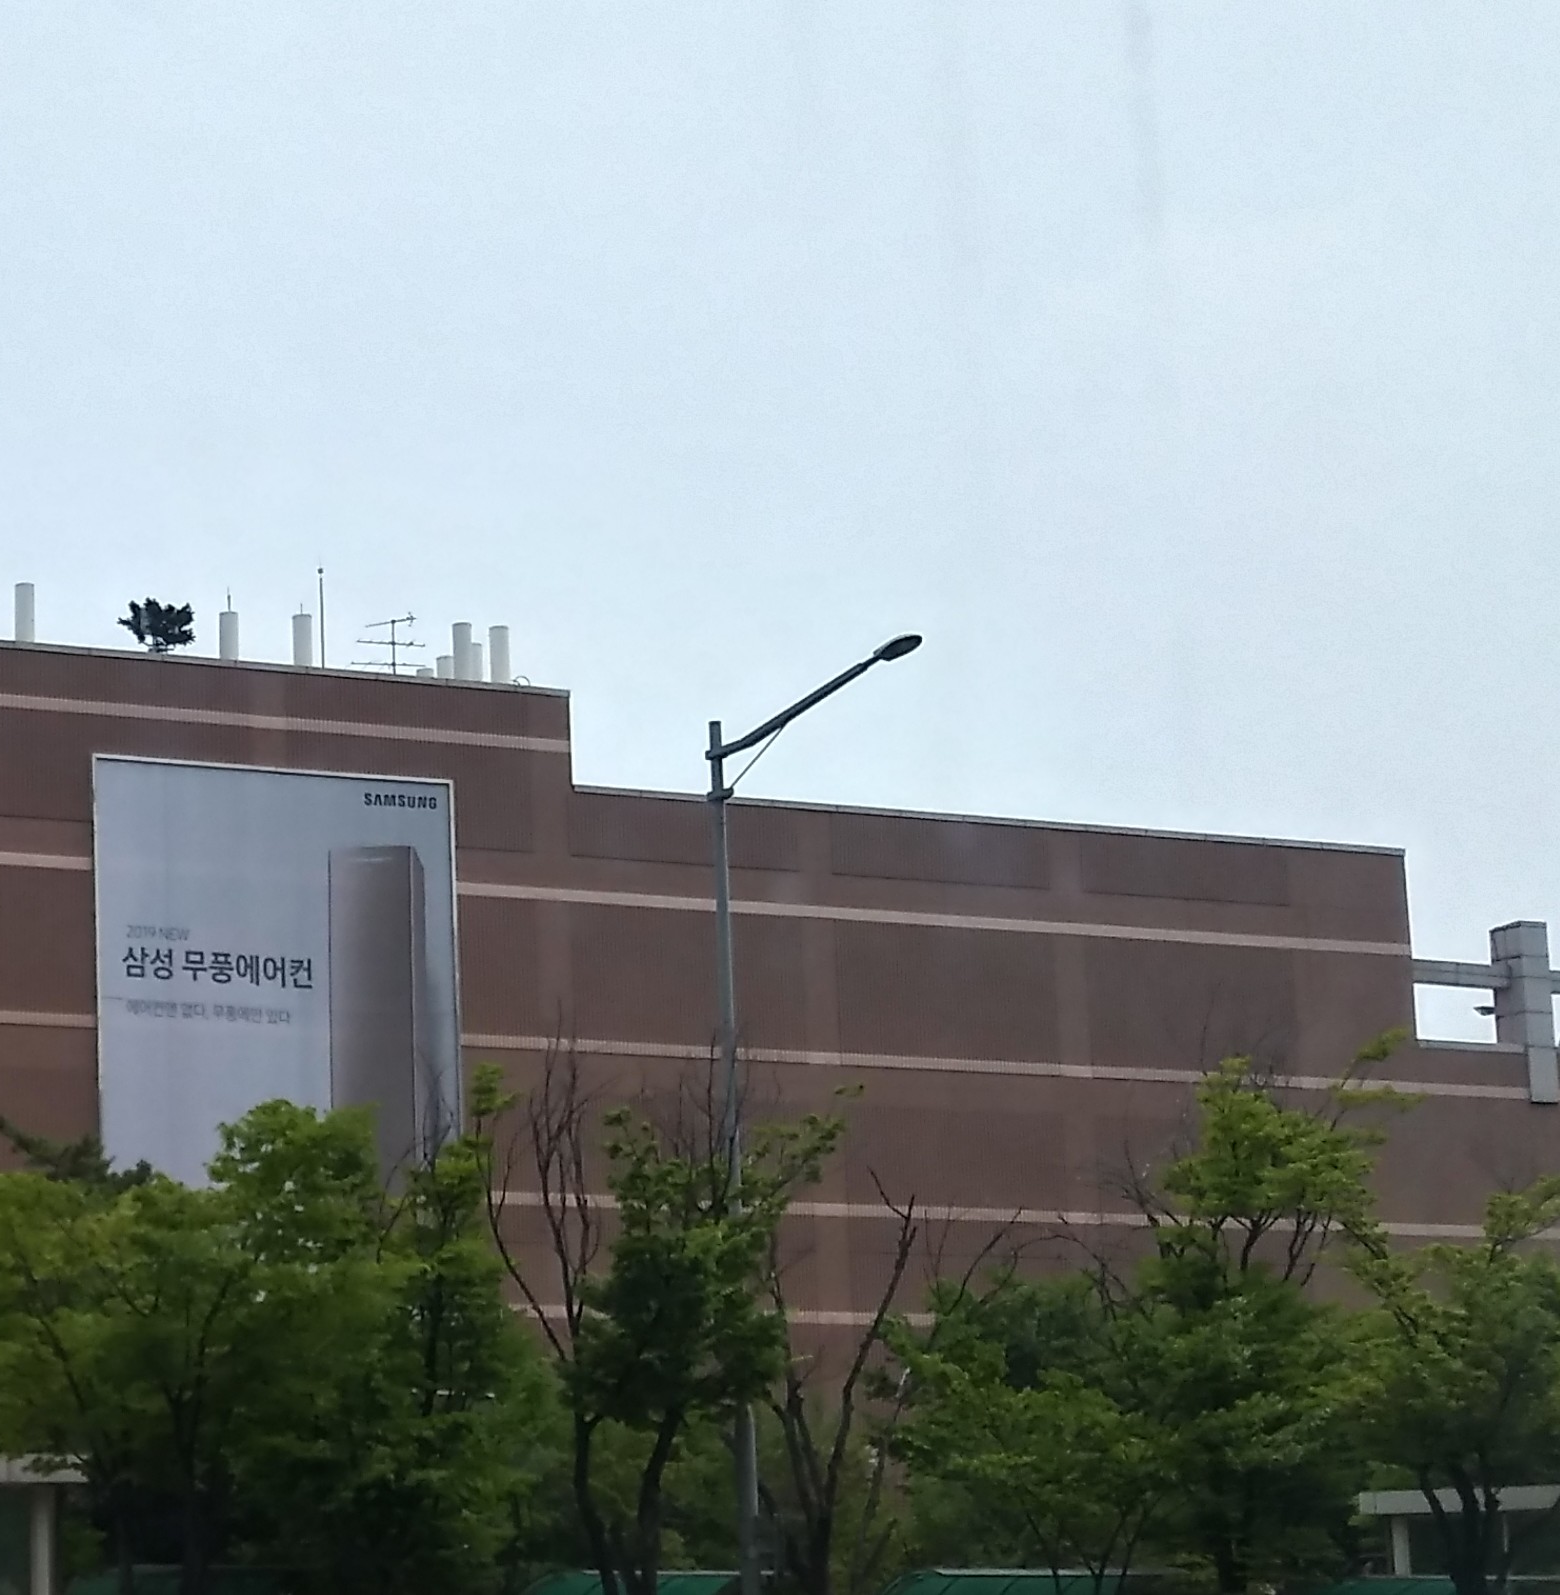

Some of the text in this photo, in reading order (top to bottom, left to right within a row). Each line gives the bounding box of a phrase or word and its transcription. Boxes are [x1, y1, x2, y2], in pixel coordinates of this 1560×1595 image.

[363, 792, 438, 810] SAMSUNG
[126, 924, 191, 941] 2019 NEW
[121, 946, 314, 990] 삼성 무풍에어컨
